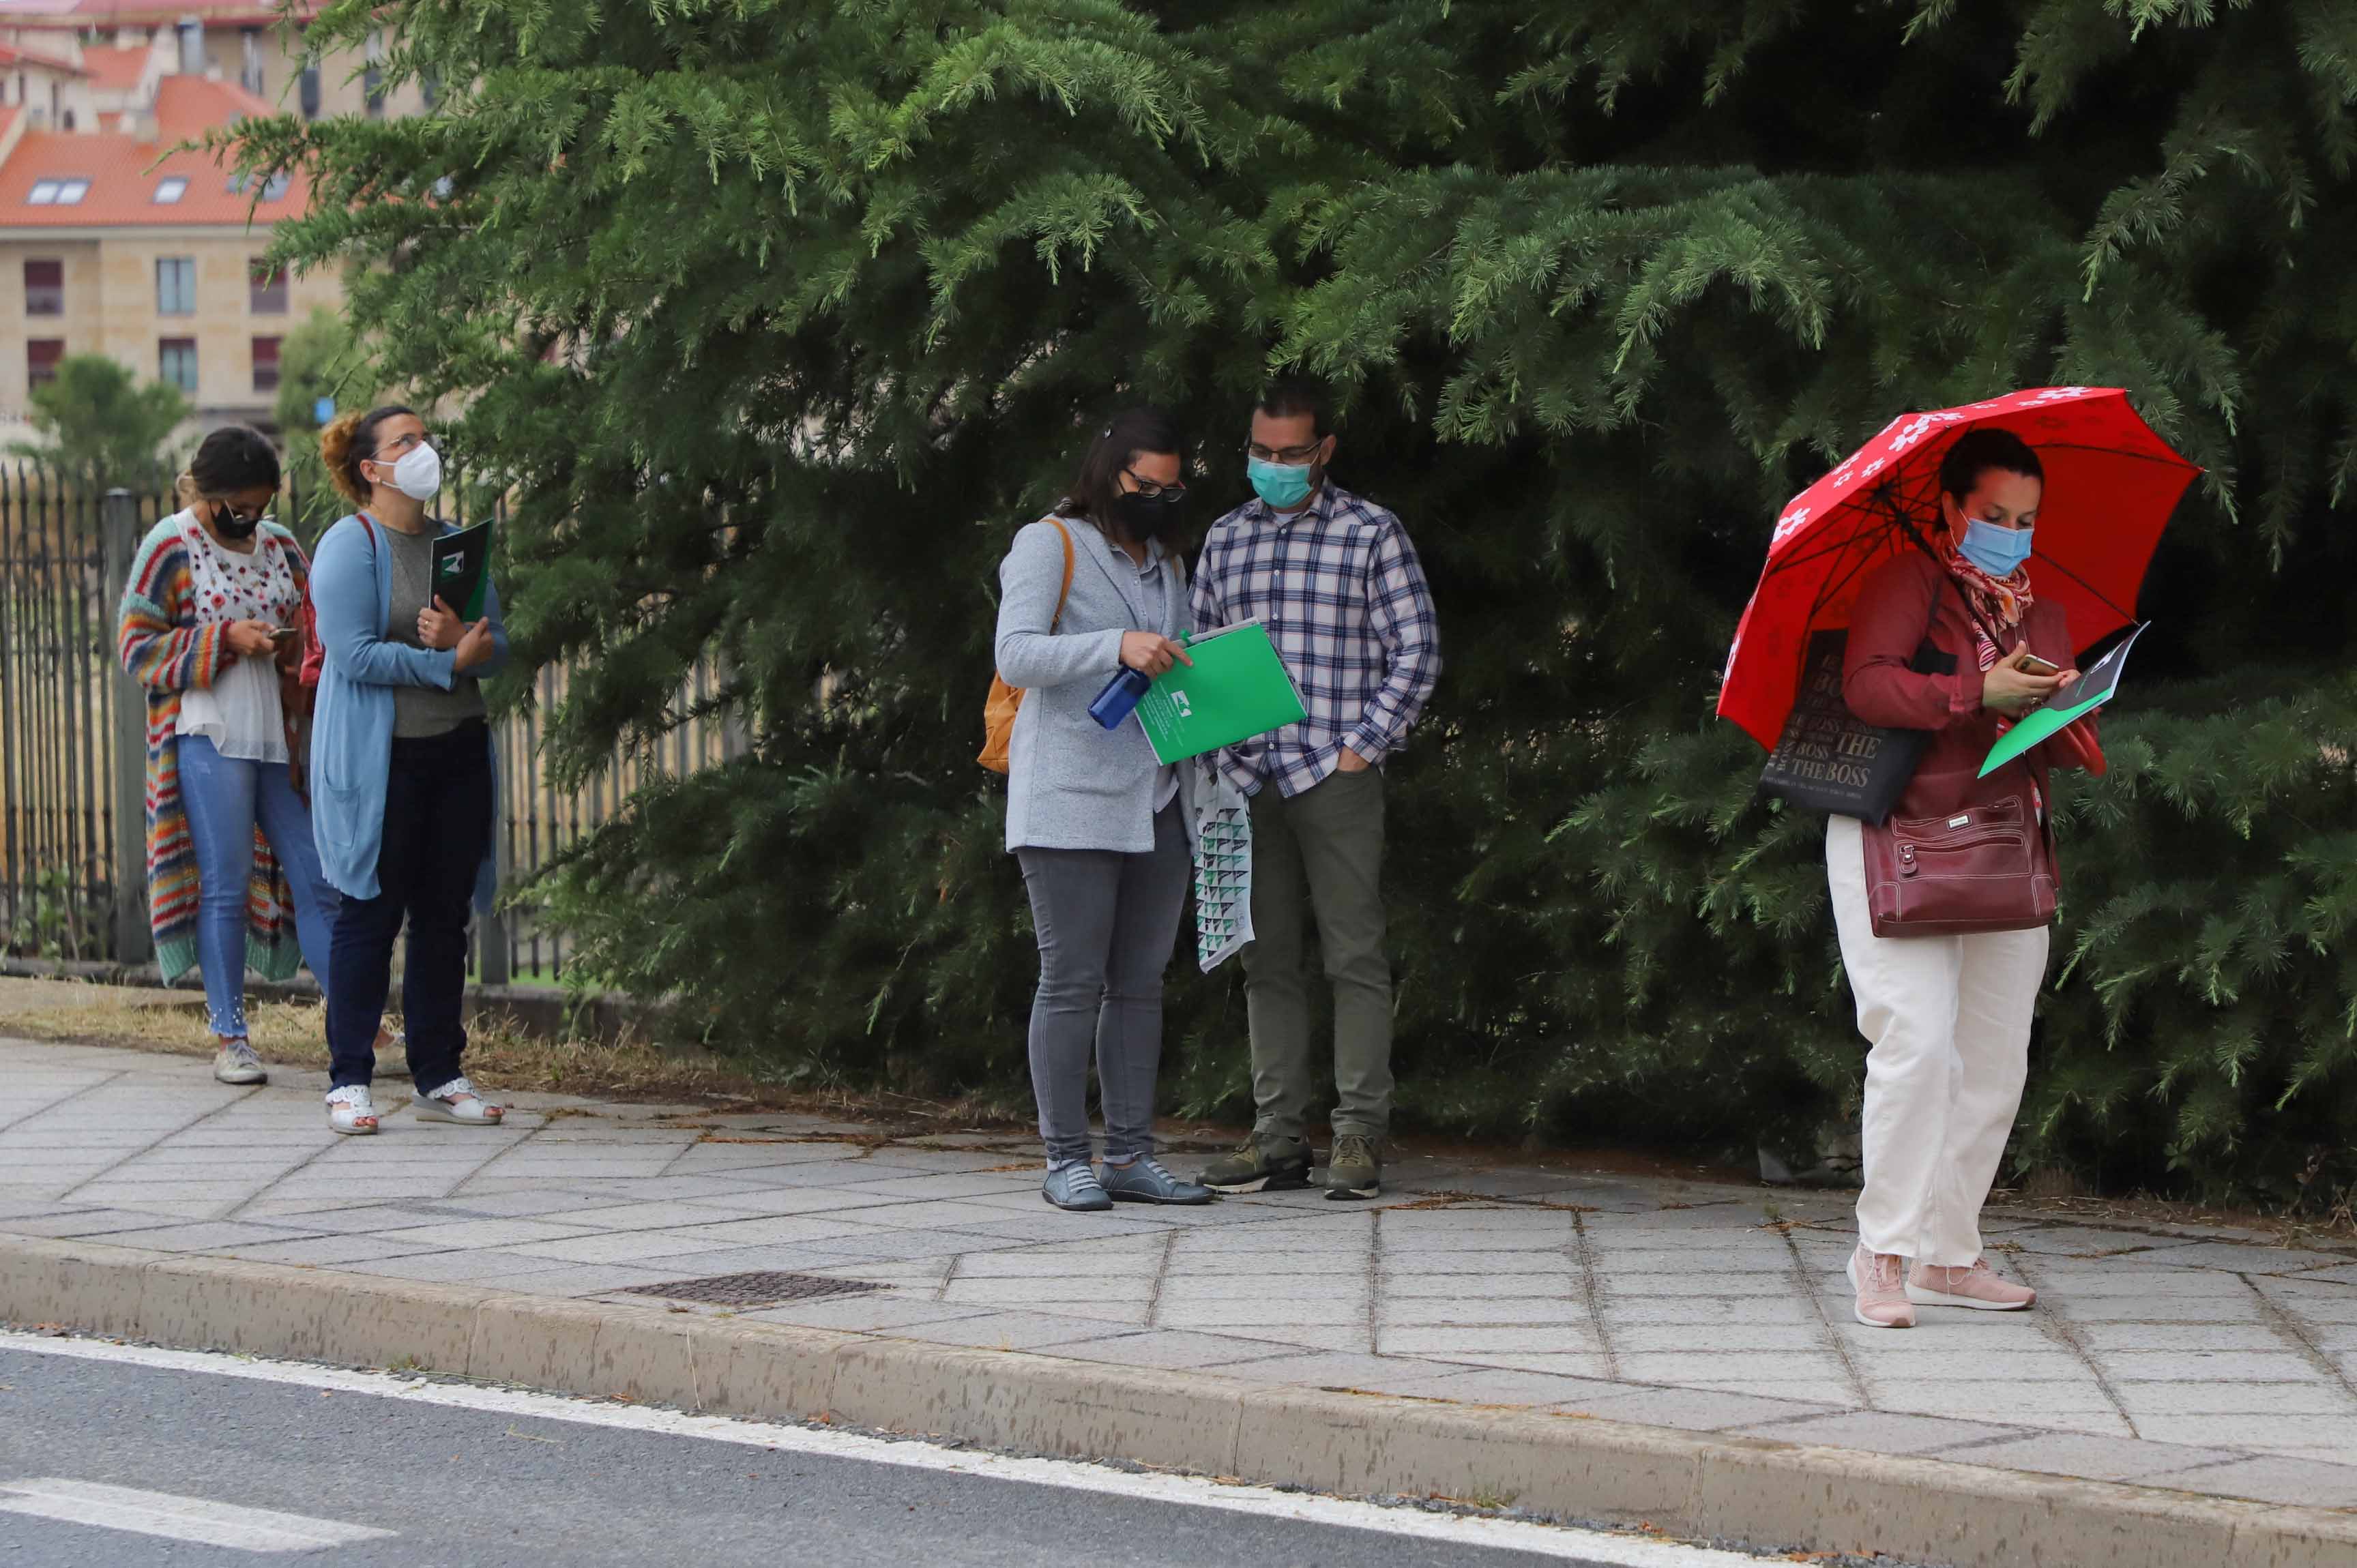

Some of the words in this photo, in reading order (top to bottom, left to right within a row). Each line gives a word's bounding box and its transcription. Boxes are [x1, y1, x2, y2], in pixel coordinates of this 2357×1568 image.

[1796, 741, 1829, 760] BOSS
[1835, 732, 1882, 759] THE
[1791, 758, 1825, 780] THE
[1826, 762, 1871, 787] BOSS
